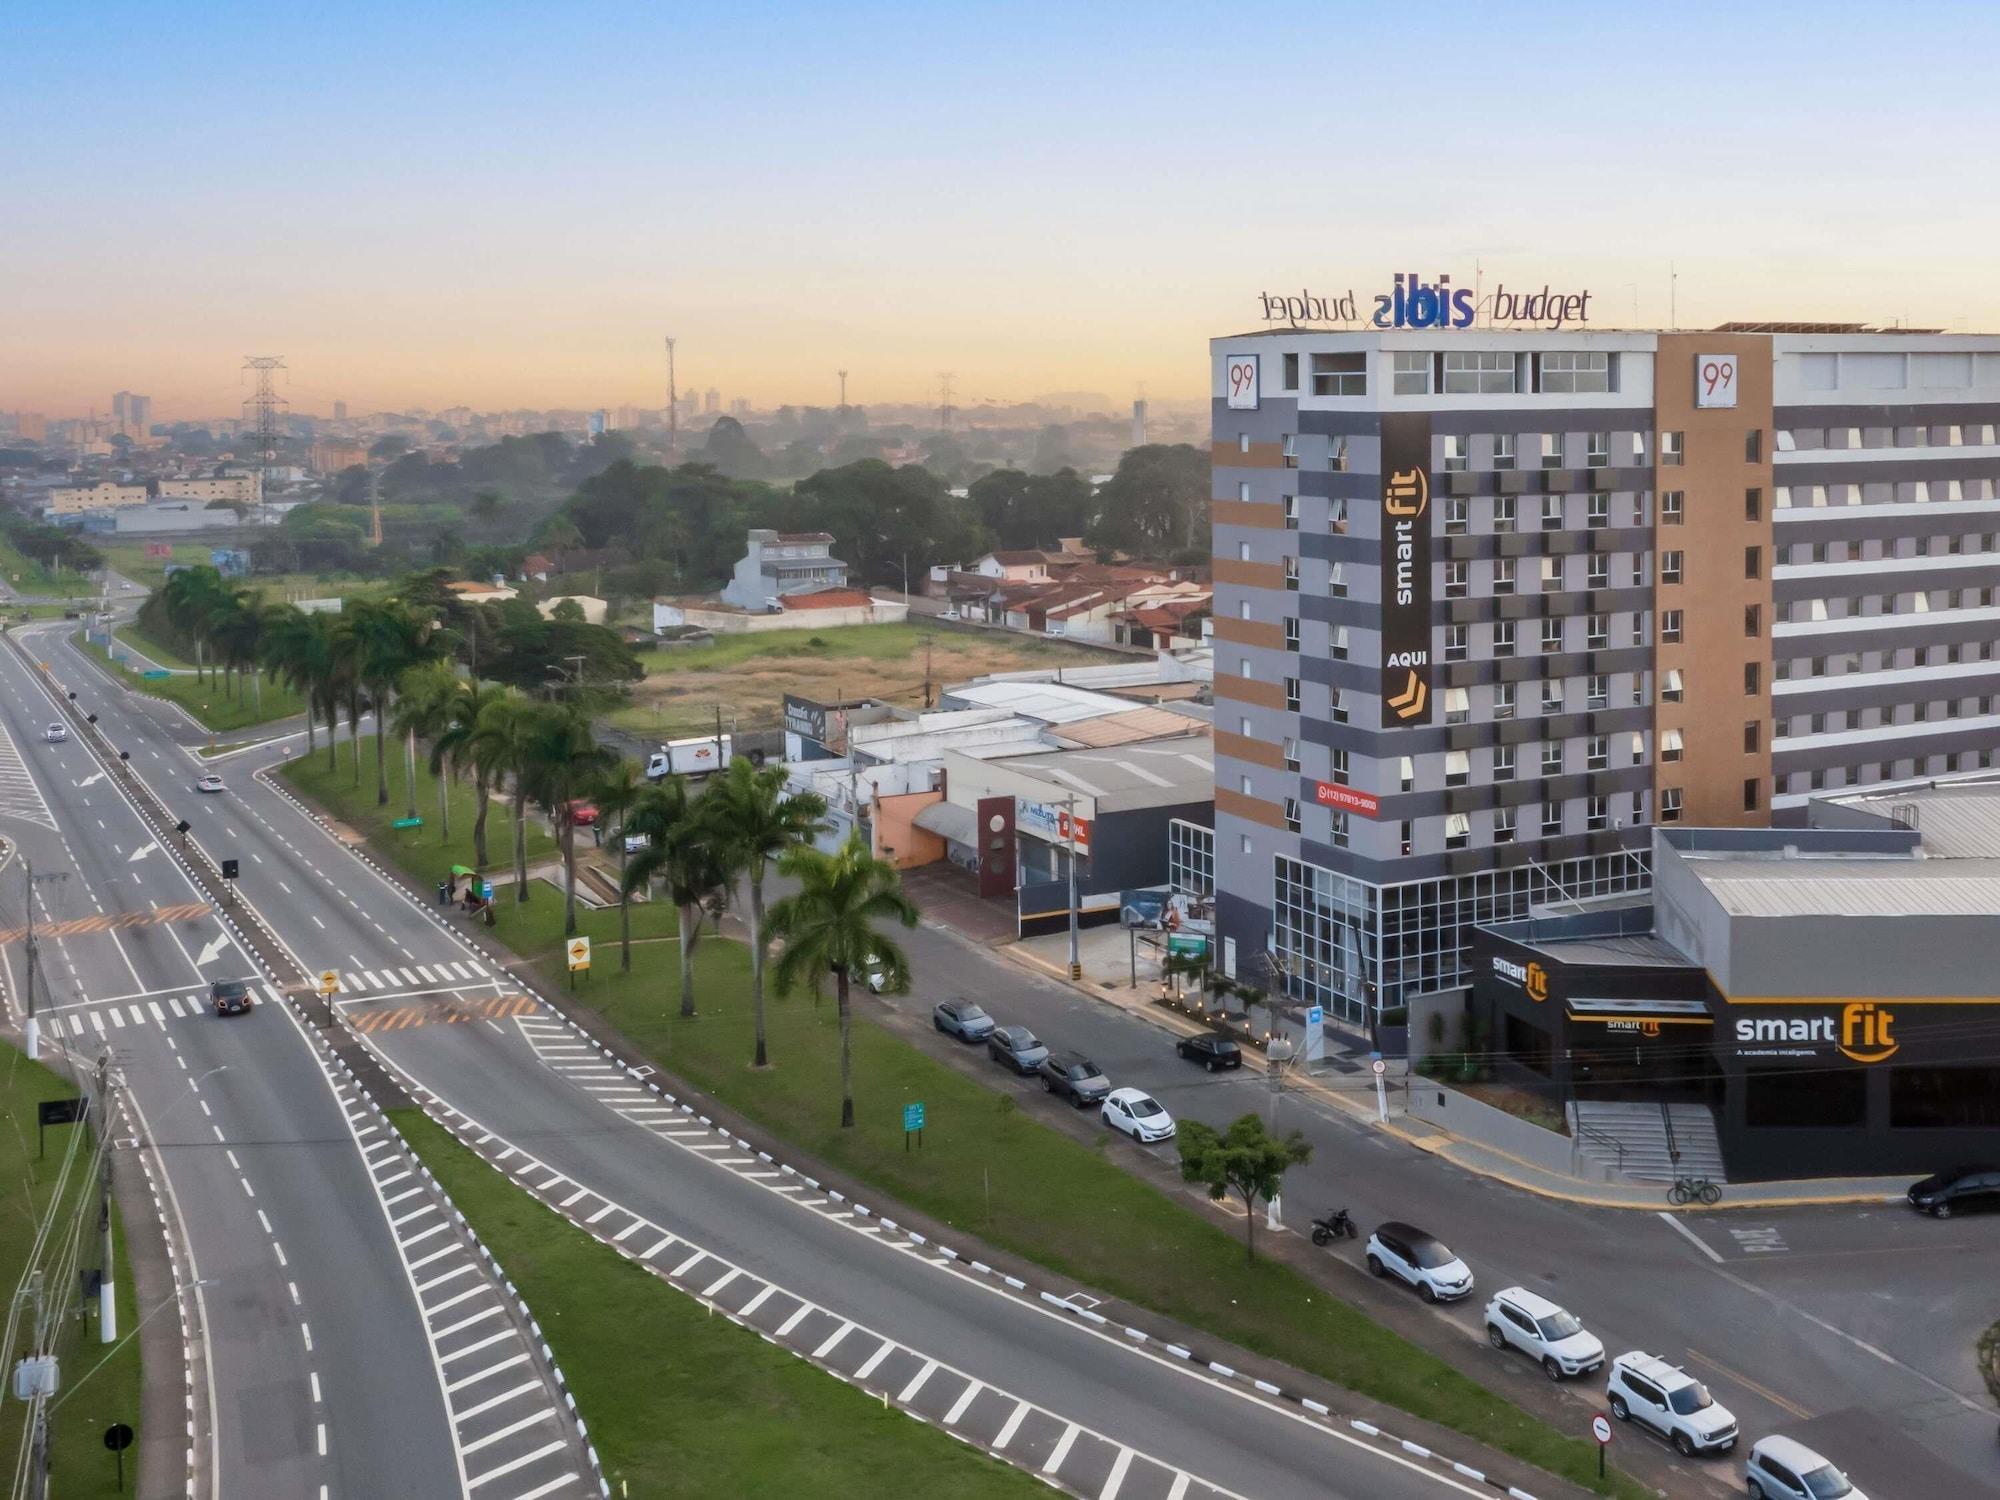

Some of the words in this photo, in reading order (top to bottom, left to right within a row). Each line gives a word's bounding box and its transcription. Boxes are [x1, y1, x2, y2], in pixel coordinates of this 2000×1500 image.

[1394, 273, 1475, 328] ibis
[1494, 284, 1593, 330] budget
[1231, 364, 1254, 397] 99
[1703, 363, 1733, 396] 99
[1385, 469, 1417, 516] fit
[1395, 520, 1413, 606] smart
[1387, 651, 1427, 668] AQUI
[1493, 957, 1527, 982] smart
[1528, 962, 1548, 994] fit
[1735, 1016, 1835, 1041] smart
[1842, 1003, 1895, 1046] fit
